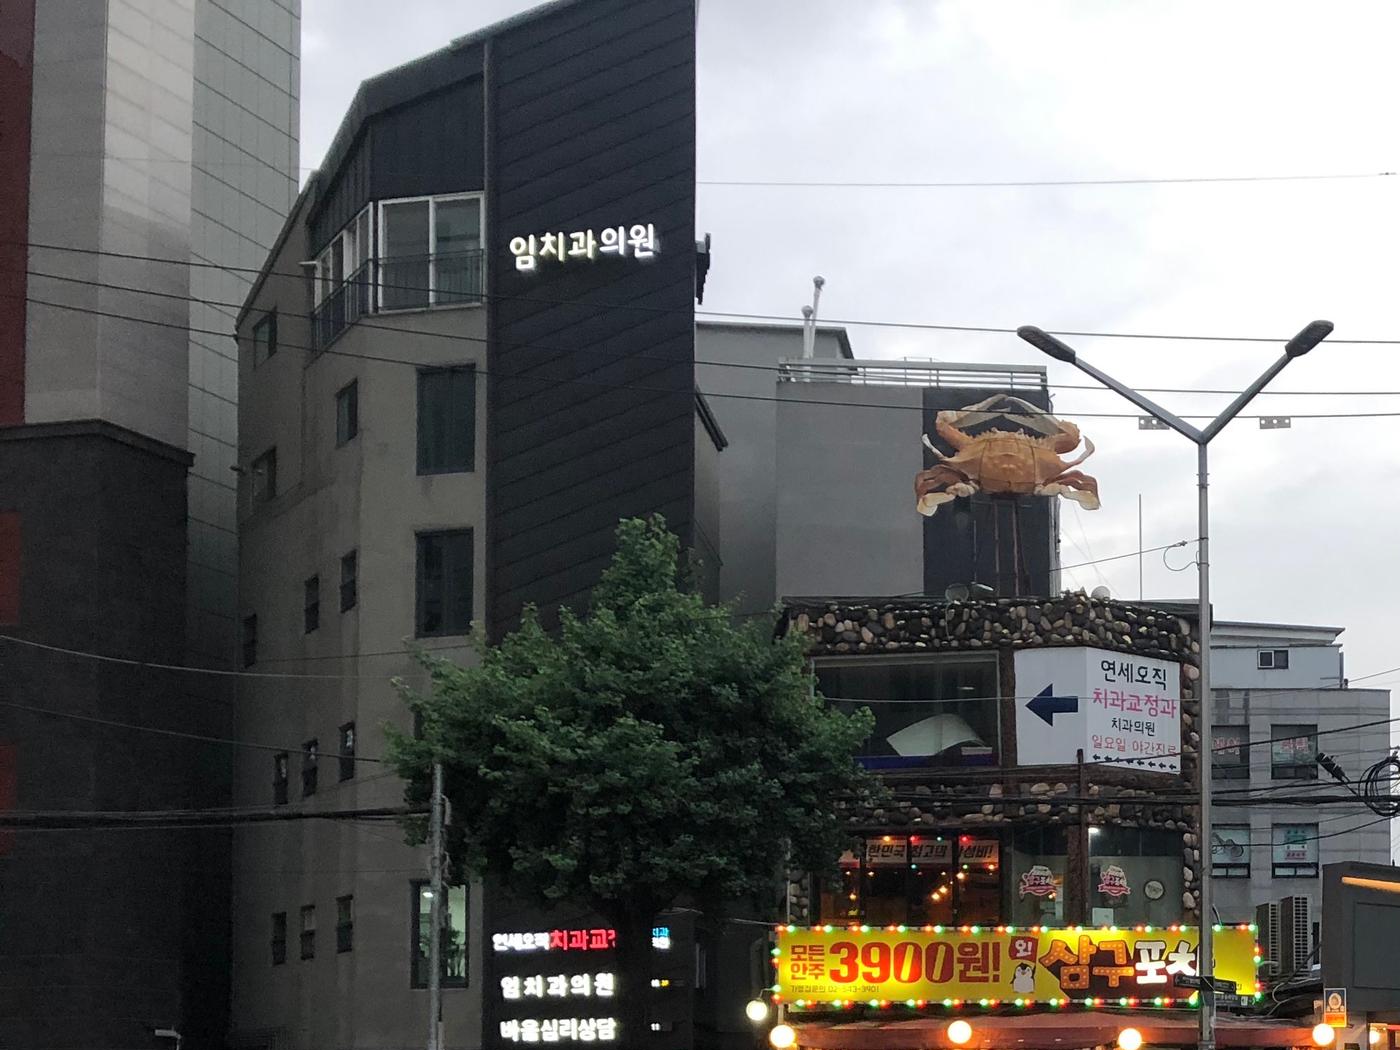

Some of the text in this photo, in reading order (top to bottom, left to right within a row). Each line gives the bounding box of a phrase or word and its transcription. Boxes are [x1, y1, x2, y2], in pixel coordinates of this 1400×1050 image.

[508, 223, 655, 271] 임치과의원
[1100, 659, 1167, 691] 연세오직
[1092, 687, 1177, 719] 치과교정과
[1111, 717, 1155, 737] 치과의원
[1091, 734, 1126, 752] 일요일
[790, 944, 825, 962] 모든
[829, 941, 1000, 983] 3900원!
[790, 963, 825, 981] 안주
[500, 973, 615, 999] 임치과의원
